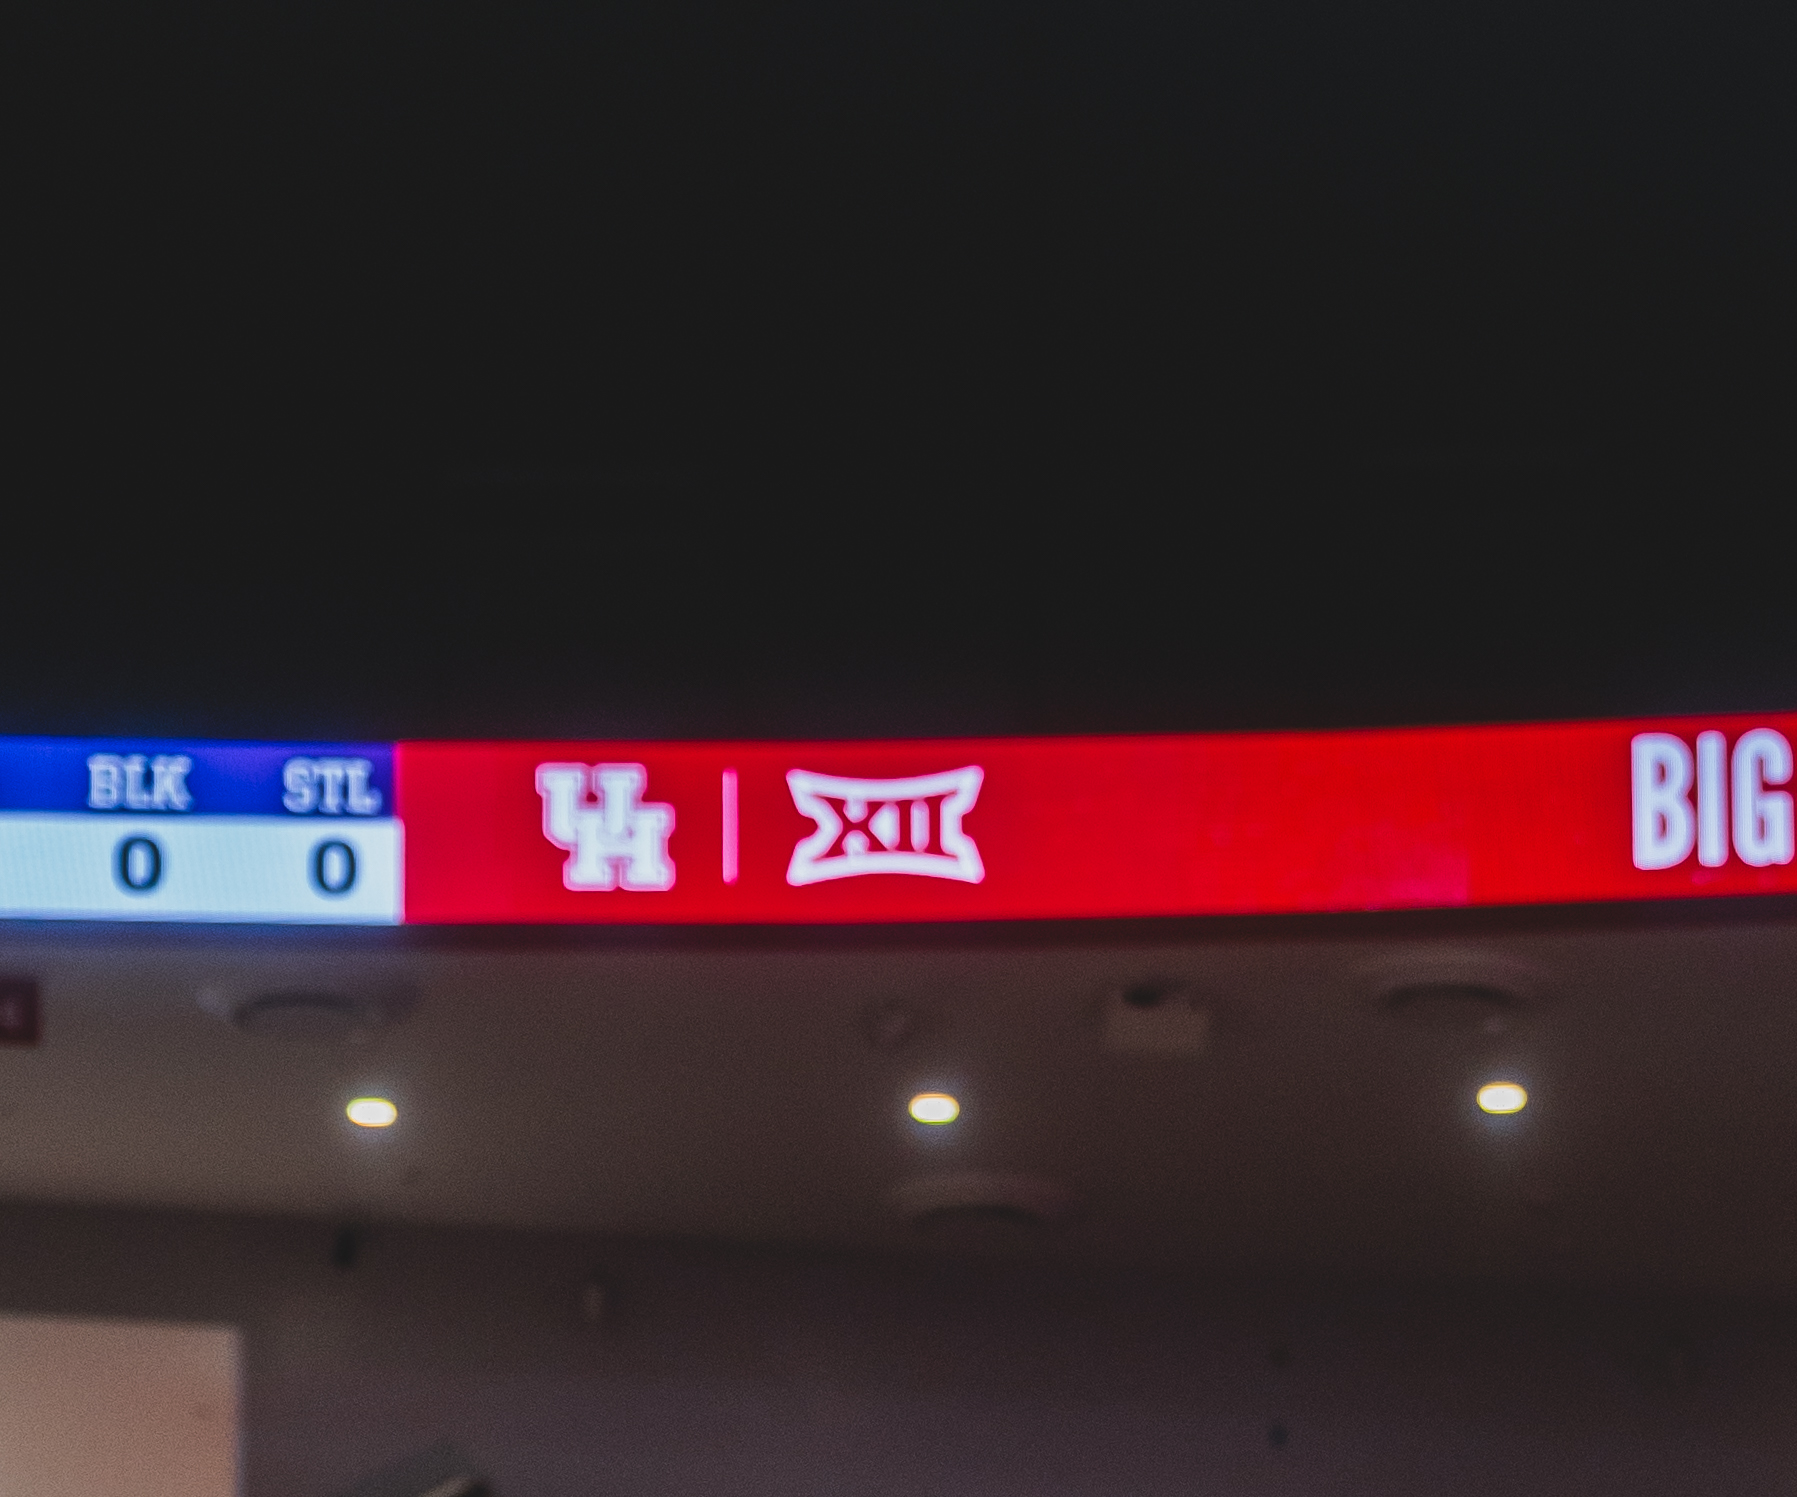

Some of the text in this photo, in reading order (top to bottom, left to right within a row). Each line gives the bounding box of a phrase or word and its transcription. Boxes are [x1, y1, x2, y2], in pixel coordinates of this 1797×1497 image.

[86, 753, 383, 816] BLK STL
[1631, 728, 1795, 870] BIG
[116, 836, 359, 895] 0 0
